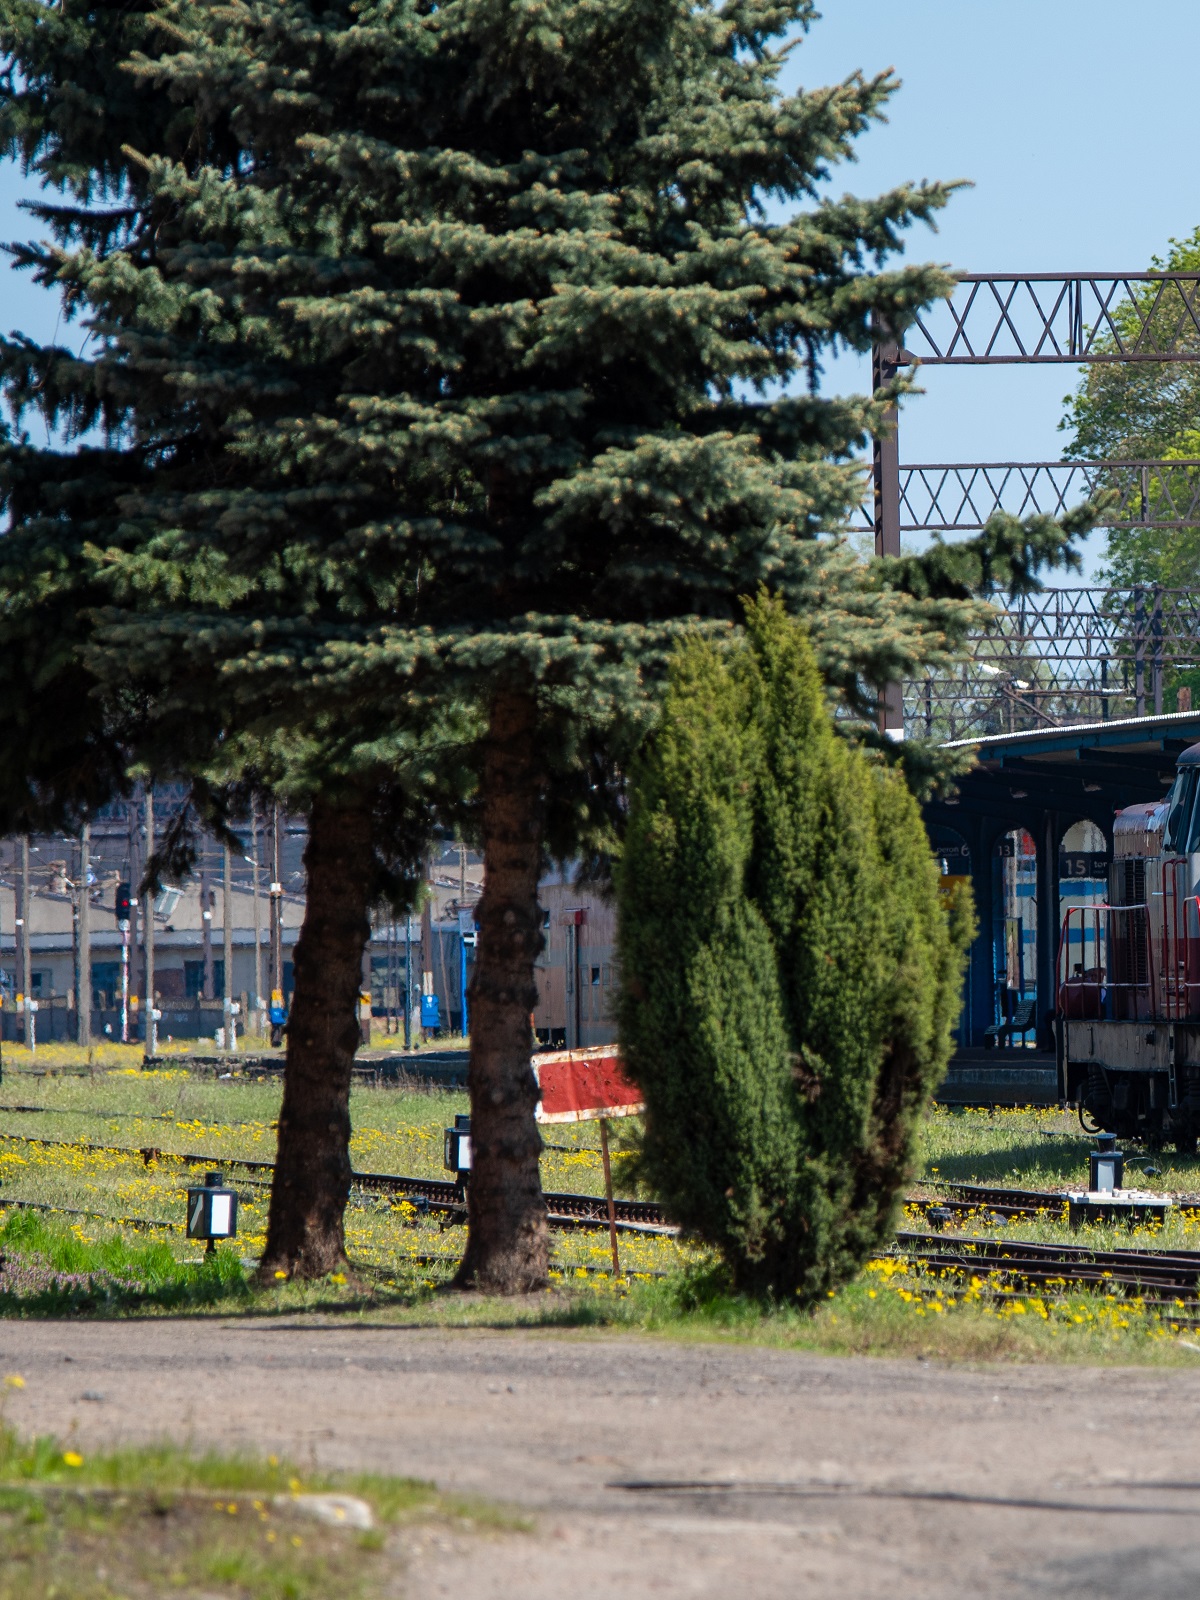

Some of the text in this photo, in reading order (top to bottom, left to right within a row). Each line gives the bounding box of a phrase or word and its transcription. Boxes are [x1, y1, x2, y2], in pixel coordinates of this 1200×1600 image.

[998, 843, 1011, 856] 13
[1065, 859, 1087, 875] 15
[1093, 860, 1108, 868] tor
